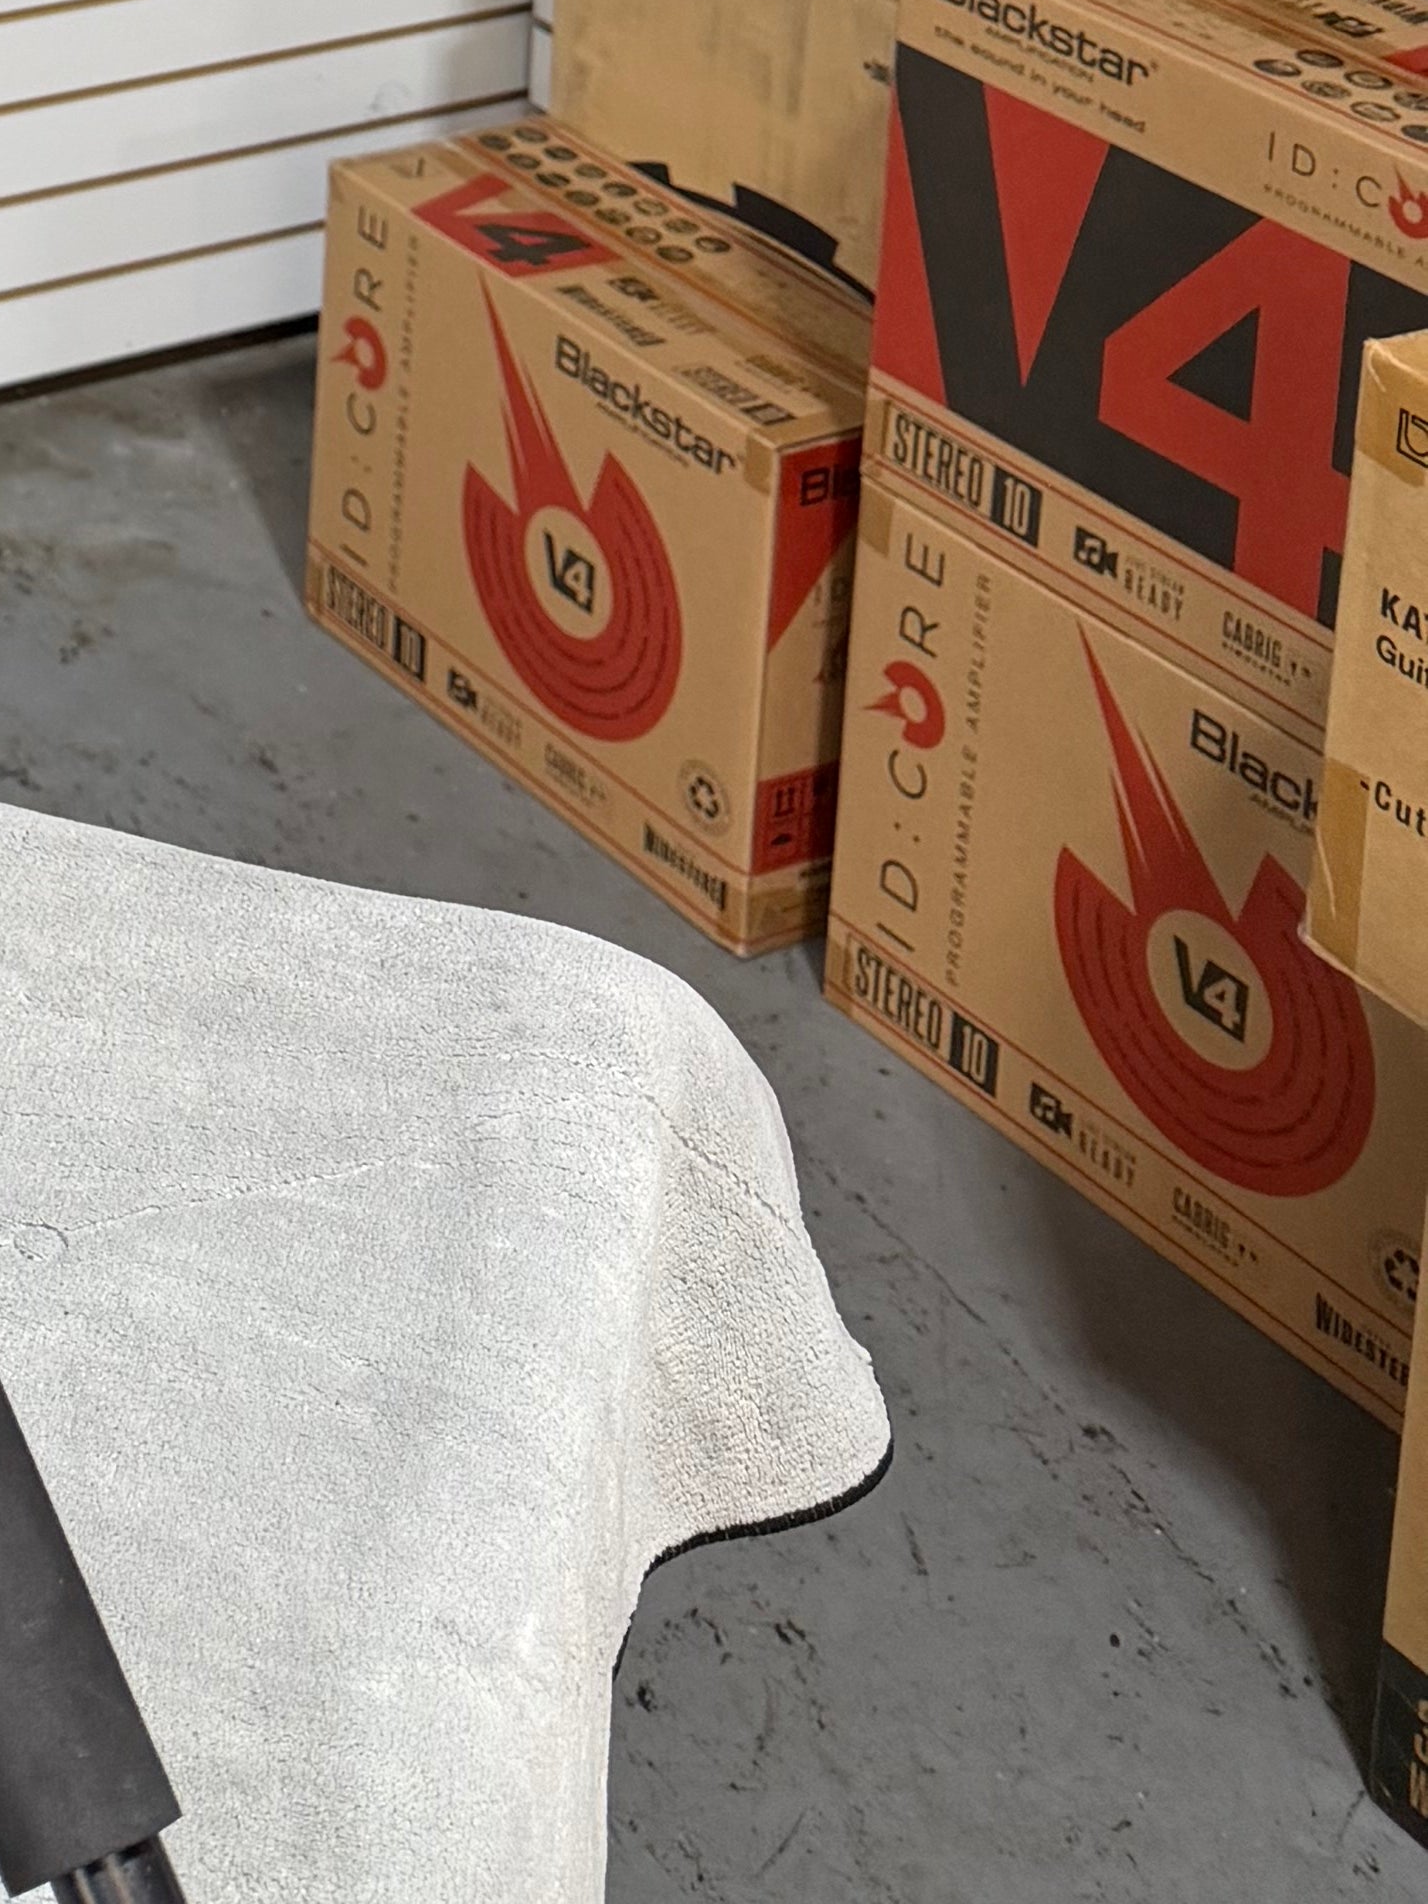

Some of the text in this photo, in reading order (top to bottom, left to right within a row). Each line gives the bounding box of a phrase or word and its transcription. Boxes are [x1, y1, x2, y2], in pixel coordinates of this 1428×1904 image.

[555, 333, 737, 475] Blackstar
[892, 412, 984, 512] STEREO
[544, 530, 596, 616] V4
[1222, 611, 1283, 669] CABRIG
[944, 571, 993, 988] PROGRAMMABLE AMPLIFIER
[1190, 707, 1318, 821] Black
[854, 945, 943, 1051] STEREO
[1172, 933, 1249, 1044] V4
[1315, 1291, 1410, 1387] WIDESTER
